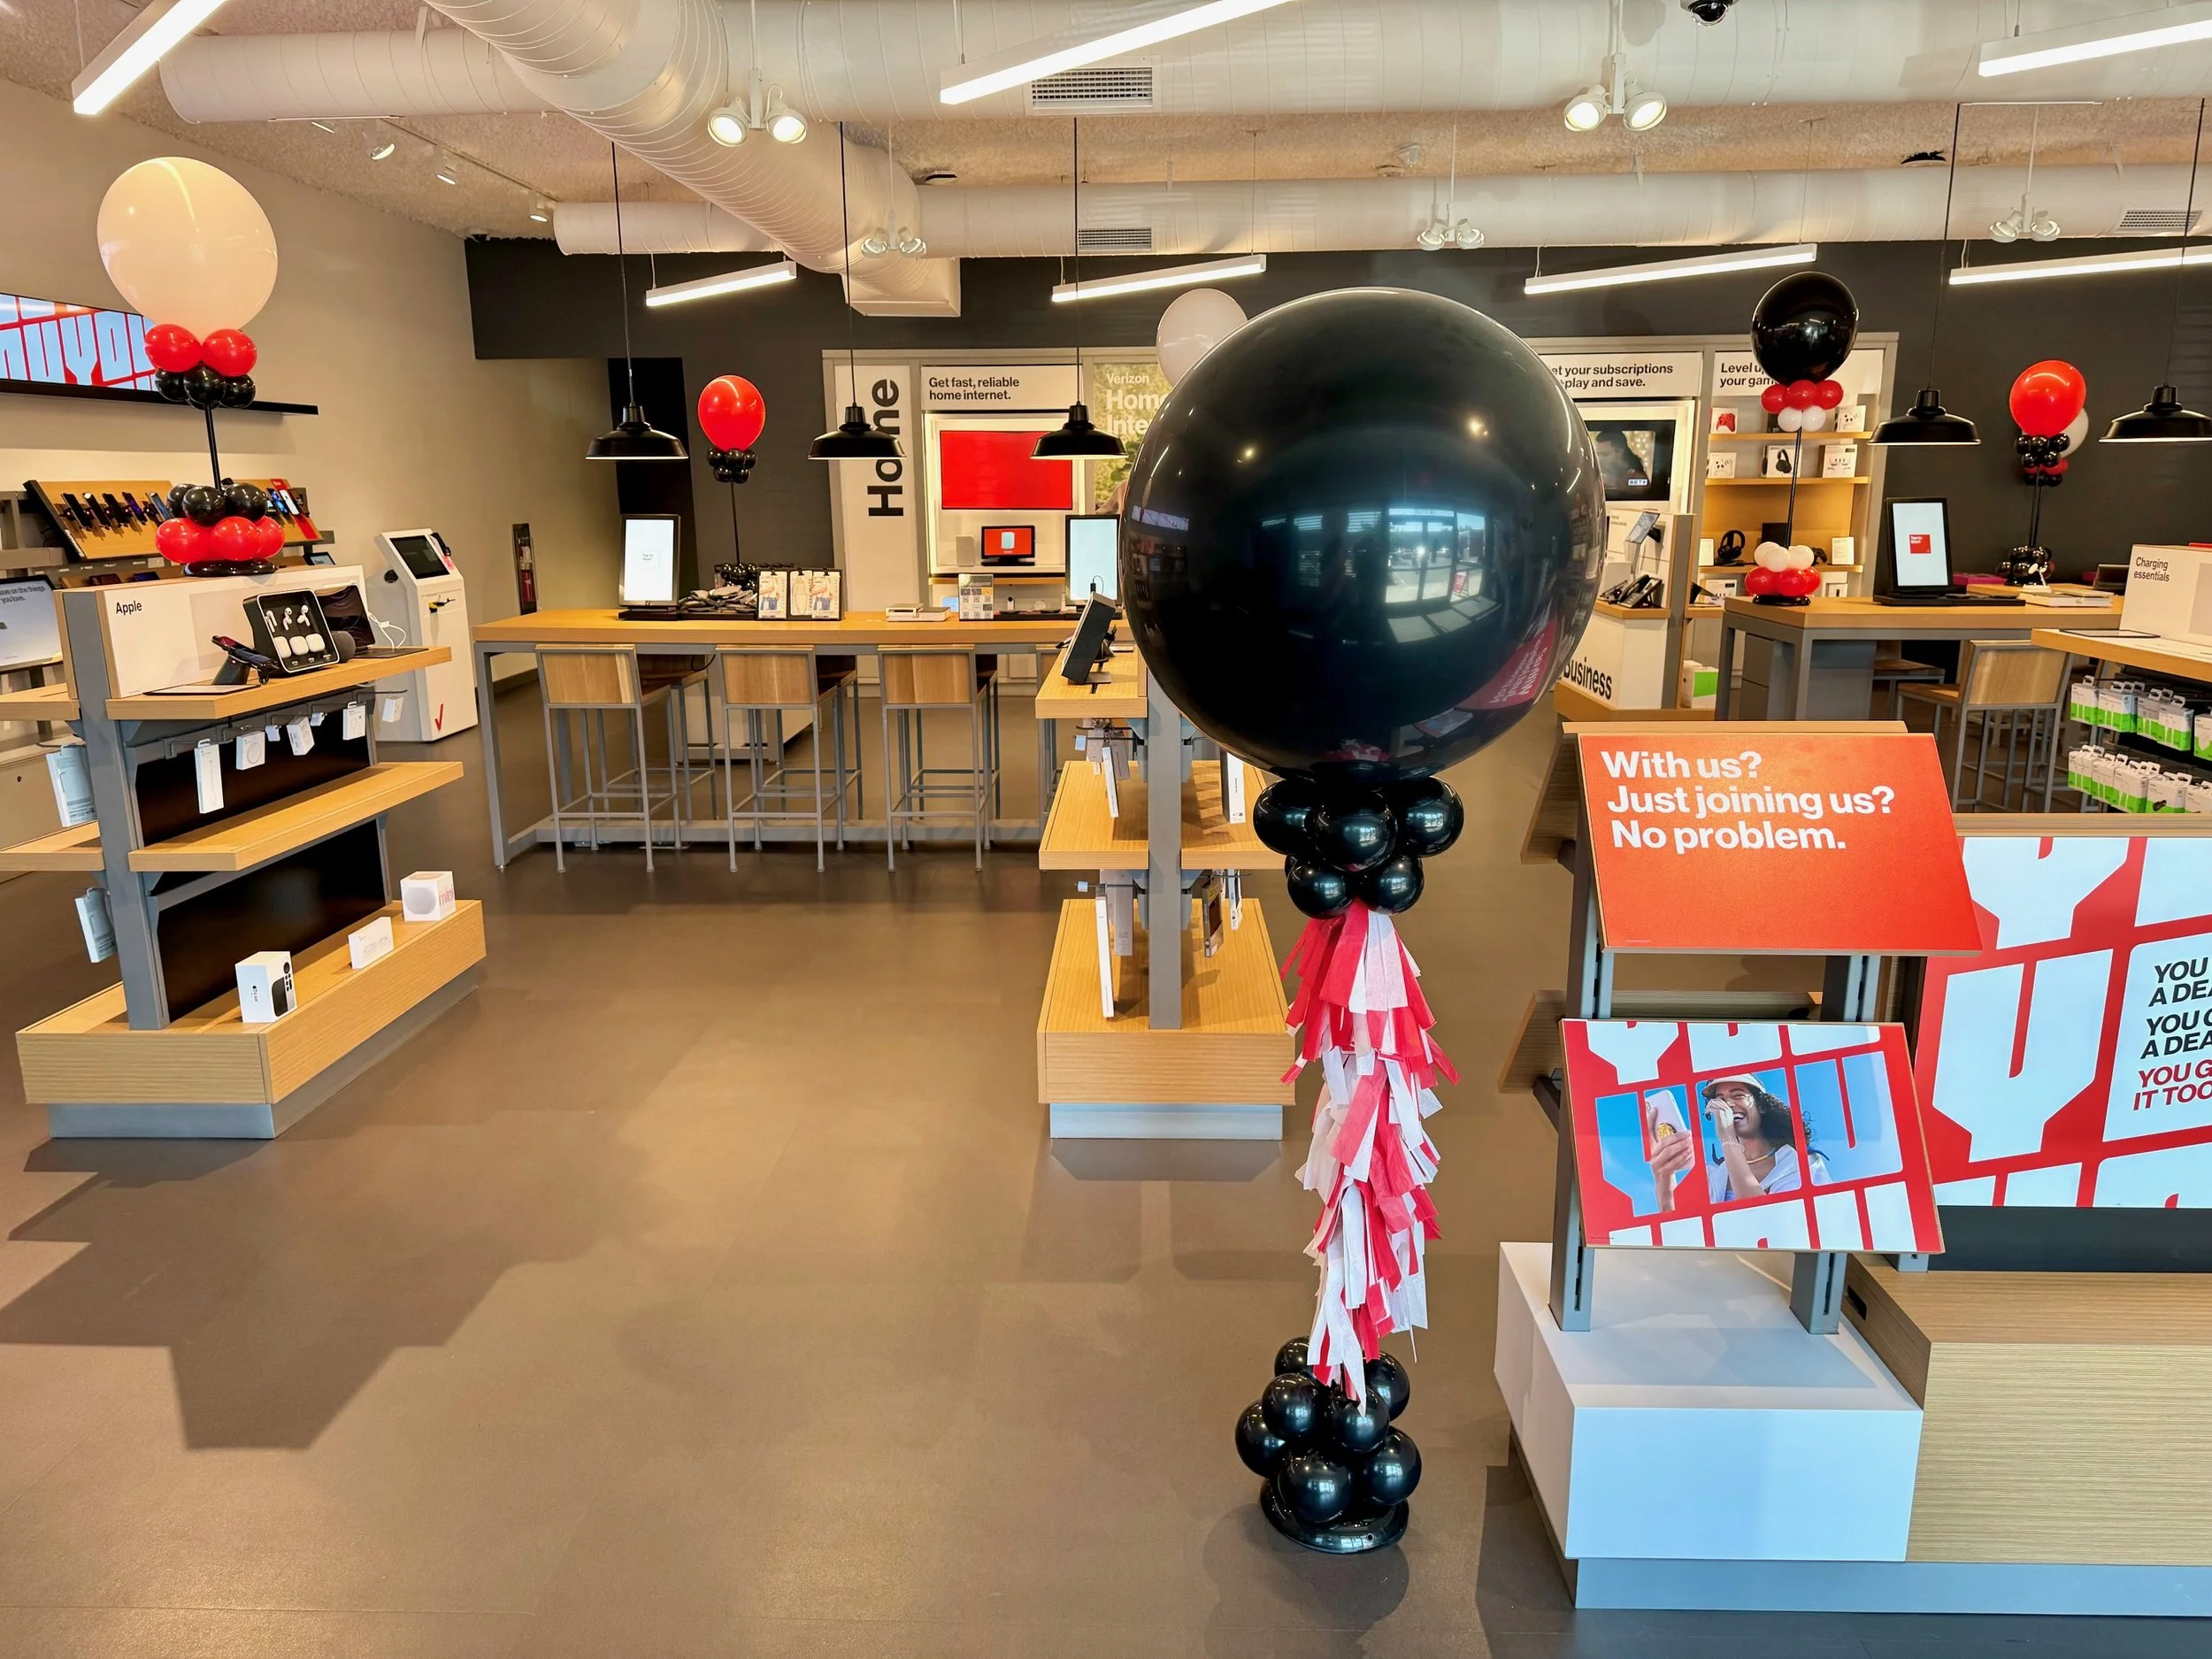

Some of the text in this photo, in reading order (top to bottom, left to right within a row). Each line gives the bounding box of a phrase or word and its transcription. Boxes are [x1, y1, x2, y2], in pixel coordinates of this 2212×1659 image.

[1564, 365, 1592, 377] your
[1593, 364, 1673, 376] subscriptions
[1721, 362, 1753, 373] Level
[928, 376, 1019, 389] Get fast, reliable
[1106, 372, 1149, 384] Verizon
[1592, 377, 1613, 388] and
[1720, 377, 1774, 388] your gam
[929, 389, 1011, 400] home internet.
[1106, 414, 1155, 435] Inte
[867, 379, 903, 517] Home
[2136, 557, 2169, 571] Charging
[2133, 571, 2170, 582] essentials
[115, 601, 142, 616] Apple
[1563, 657, 1612, 700] Business
[1600, 750, 1763, 779] With us?
[1607, 785, 1895, 819] Just joining us?
[1611, 819, 1847, 855] No problem.
[2154, 956, 2208, 984] YOU
[2147, 987, 2167, 1007] A
[2146, 1010, 2200, 1036] YOU
[2140, 1040, 2159, 1059] A
[2138, 1062, 2192, 1088] YOU
[2133, 1089, 2158, 1110] IT
